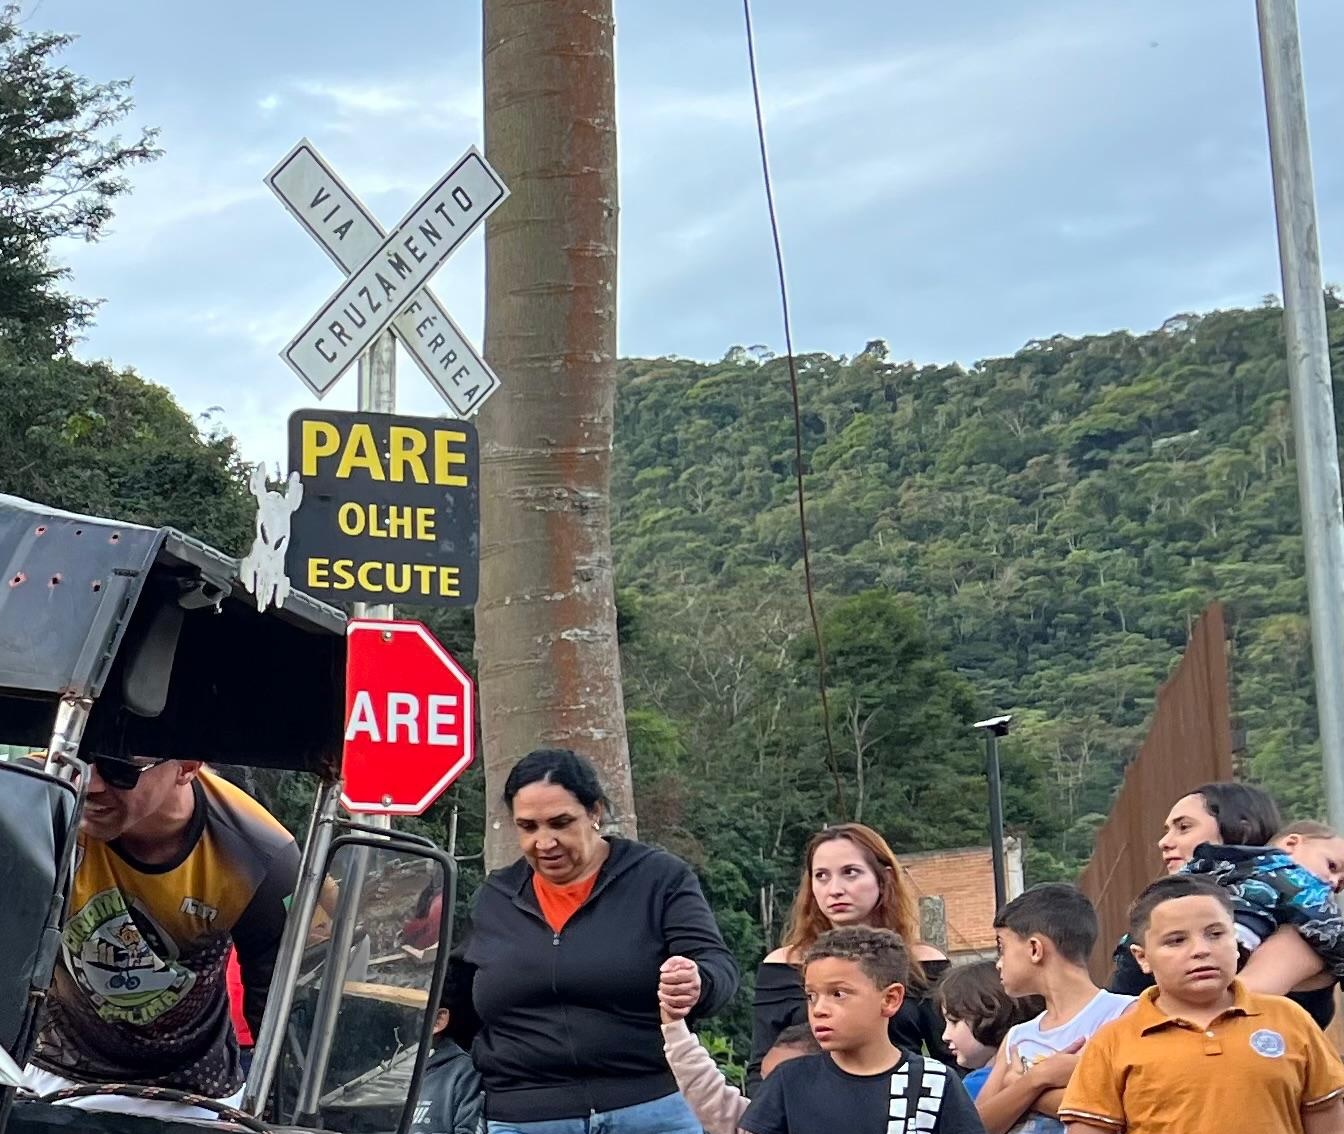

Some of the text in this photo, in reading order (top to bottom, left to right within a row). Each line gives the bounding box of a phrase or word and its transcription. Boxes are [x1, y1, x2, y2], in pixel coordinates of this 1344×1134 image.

[309, 186, 355, 240] VIA
[314, 185, 473, 364] CRUZAMENTO
[404, 299, 480, 404] FÉRREA
[302, 420, 469, 486] PARE
[338, 501, 436, 541] OLHE
[307, 558, 461, 597] ESCUTE
[346, 690, 457, 746] ARE
